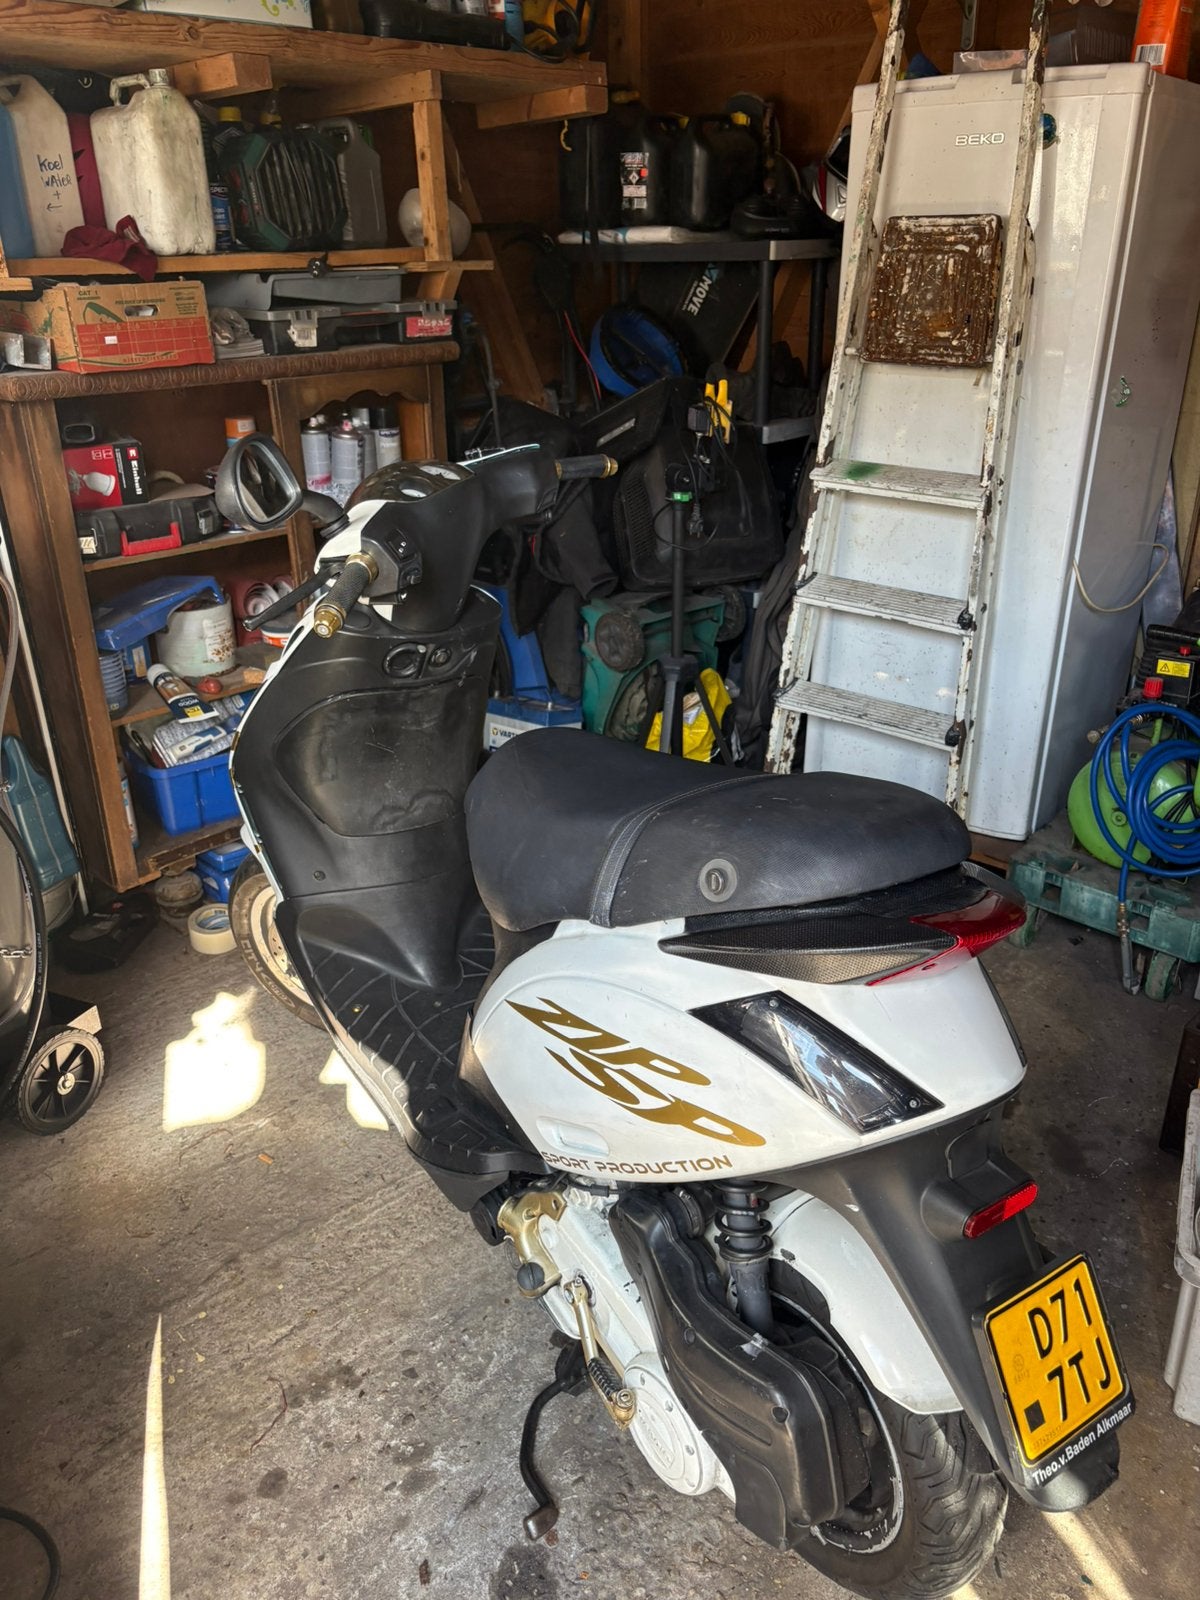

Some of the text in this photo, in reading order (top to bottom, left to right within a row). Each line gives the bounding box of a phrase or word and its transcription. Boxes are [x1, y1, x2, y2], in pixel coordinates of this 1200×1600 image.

[954, 132, 1005, 146] BEKO
[687, 275, 713, 317] MOVE
[131, 460, 143, 495] Einhell
[500, 730, 518, 738] VART
[505, 996, 712, 1087] ZIP
[543, 1045, 767, 1147] SP
[541, 1151, 733, 1175] SPORT PRODUCTION
[1027, 1277, 1093, 1360] D71
[1046, 1336, 1112, 1423] 7TJ
[1096, 1402, 1133, 1439] Alkmaar
